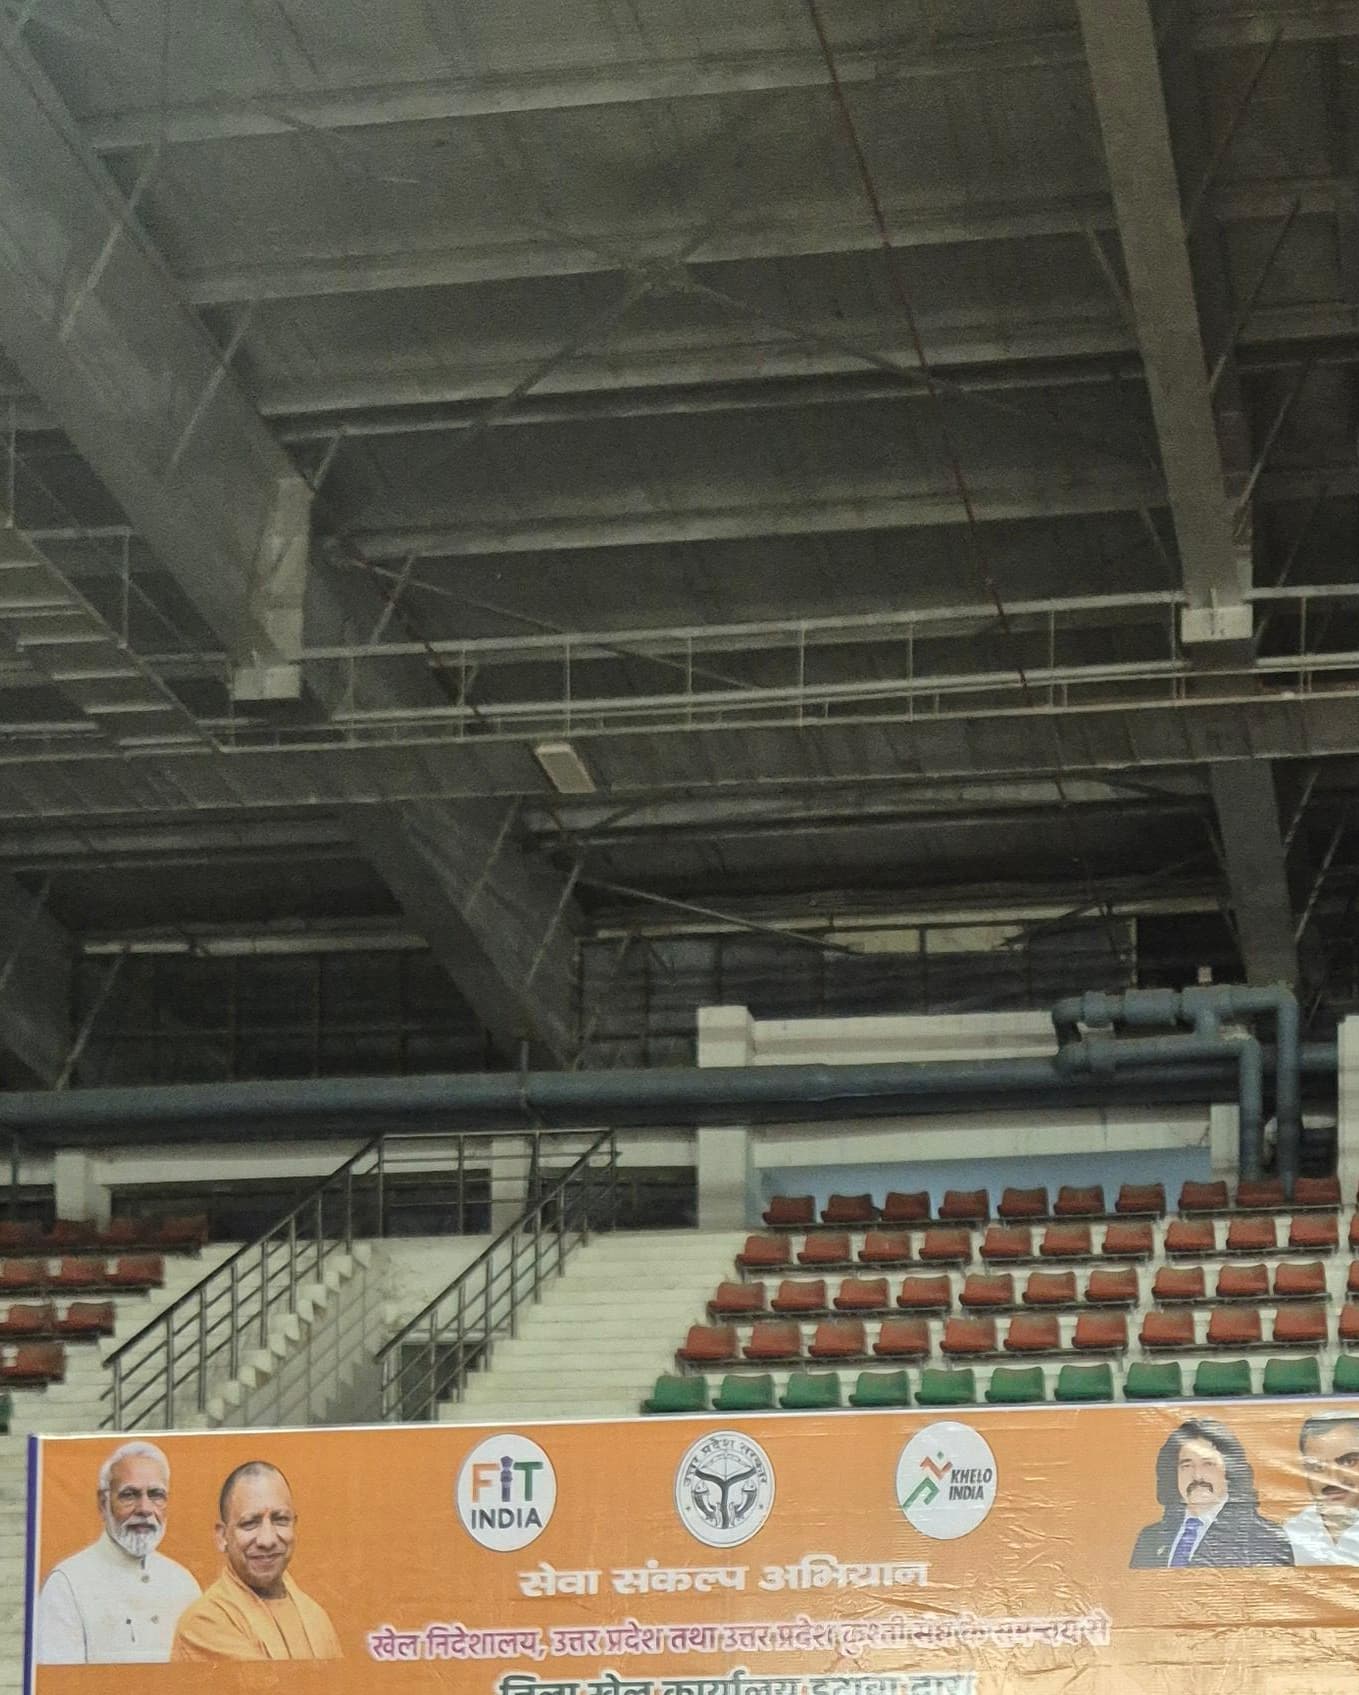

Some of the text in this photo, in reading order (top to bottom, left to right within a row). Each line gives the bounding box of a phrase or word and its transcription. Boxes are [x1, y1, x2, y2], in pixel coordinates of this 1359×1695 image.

[950, 1468, 993, 1484] KHELO
[949, 1486, 985, 1500] INDIA
[471, 1508, 542, 1530] INDIA
[519, 1555, 932, 1597] सेवा संकल्प अभियान
[371, 1628, 418, 1658] खेल
[426, 1626, 546, 1657] निदेशालय,
[553, 1629, 601, 1653] उत्तर
[605, 1622, 661, 1653] प्रदेश
[670, 1626, 717, 1651] तथा
[724, 1624, 769, 1649] उत्तर
[777, 1616, 832, 1649] प्रदेश
